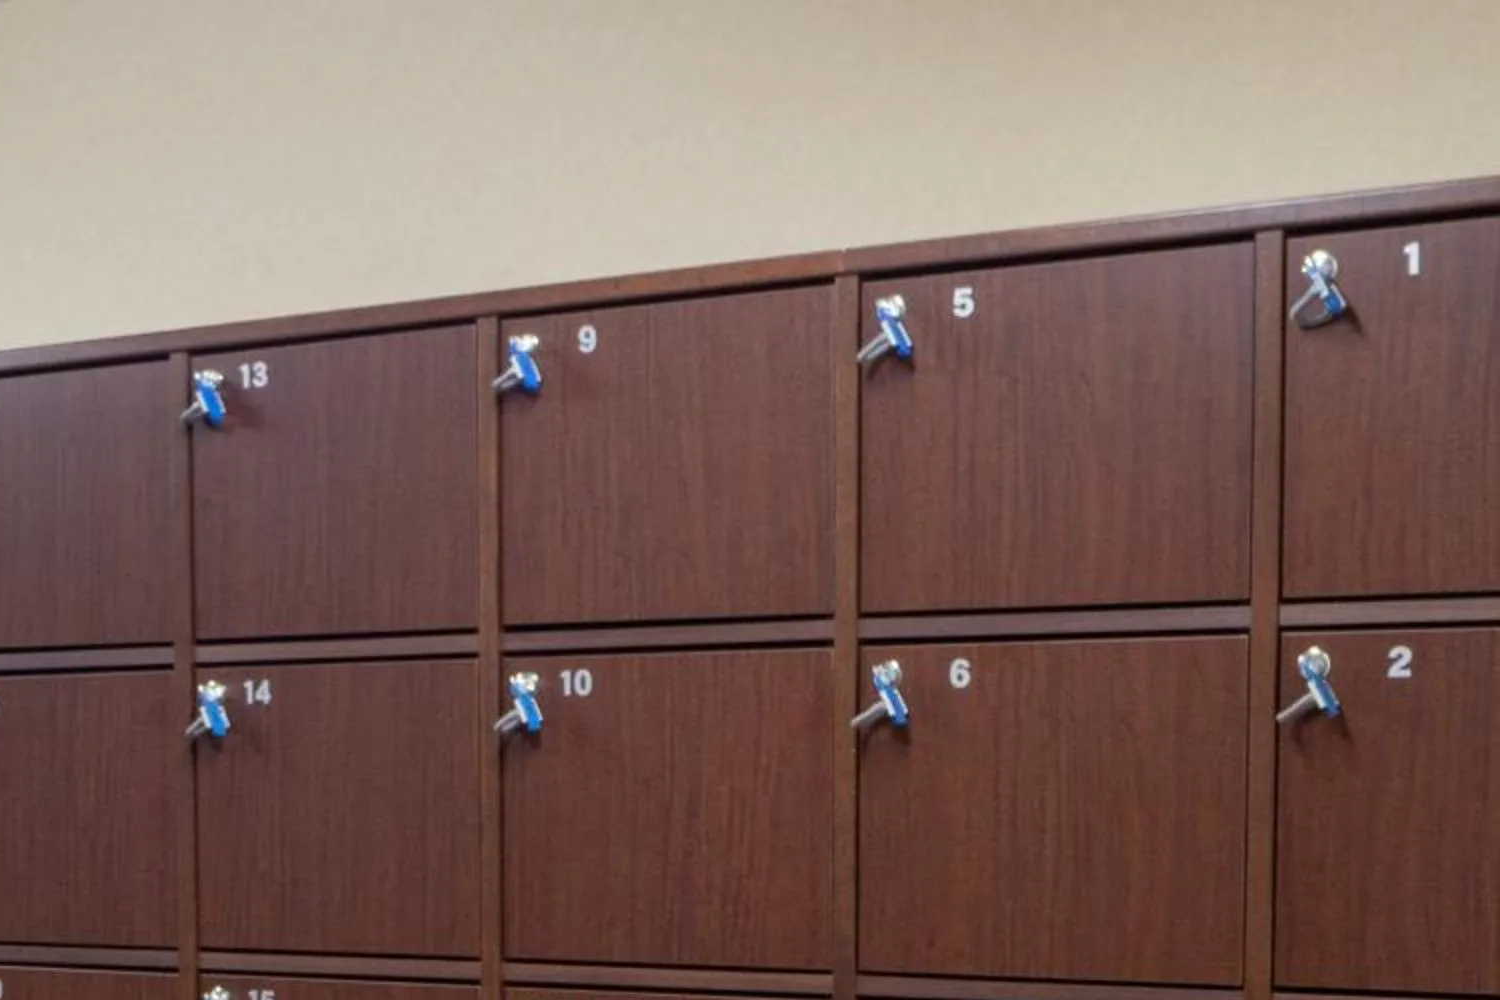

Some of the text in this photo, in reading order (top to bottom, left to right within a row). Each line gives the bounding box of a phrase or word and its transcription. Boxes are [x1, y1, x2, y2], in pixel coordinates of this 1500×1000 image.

[1403, 241, 1420, 276] 1
[952, 286, 975, 318] 5
[577, 324, 597, 354] 9
[239, 360, 269, 389] 13
[949, 658, 971, 689] 6
[1387, 645, 1413, 679] 2
[243, 679, 272, 705] 14
[560, 668, 593, 697] 10
